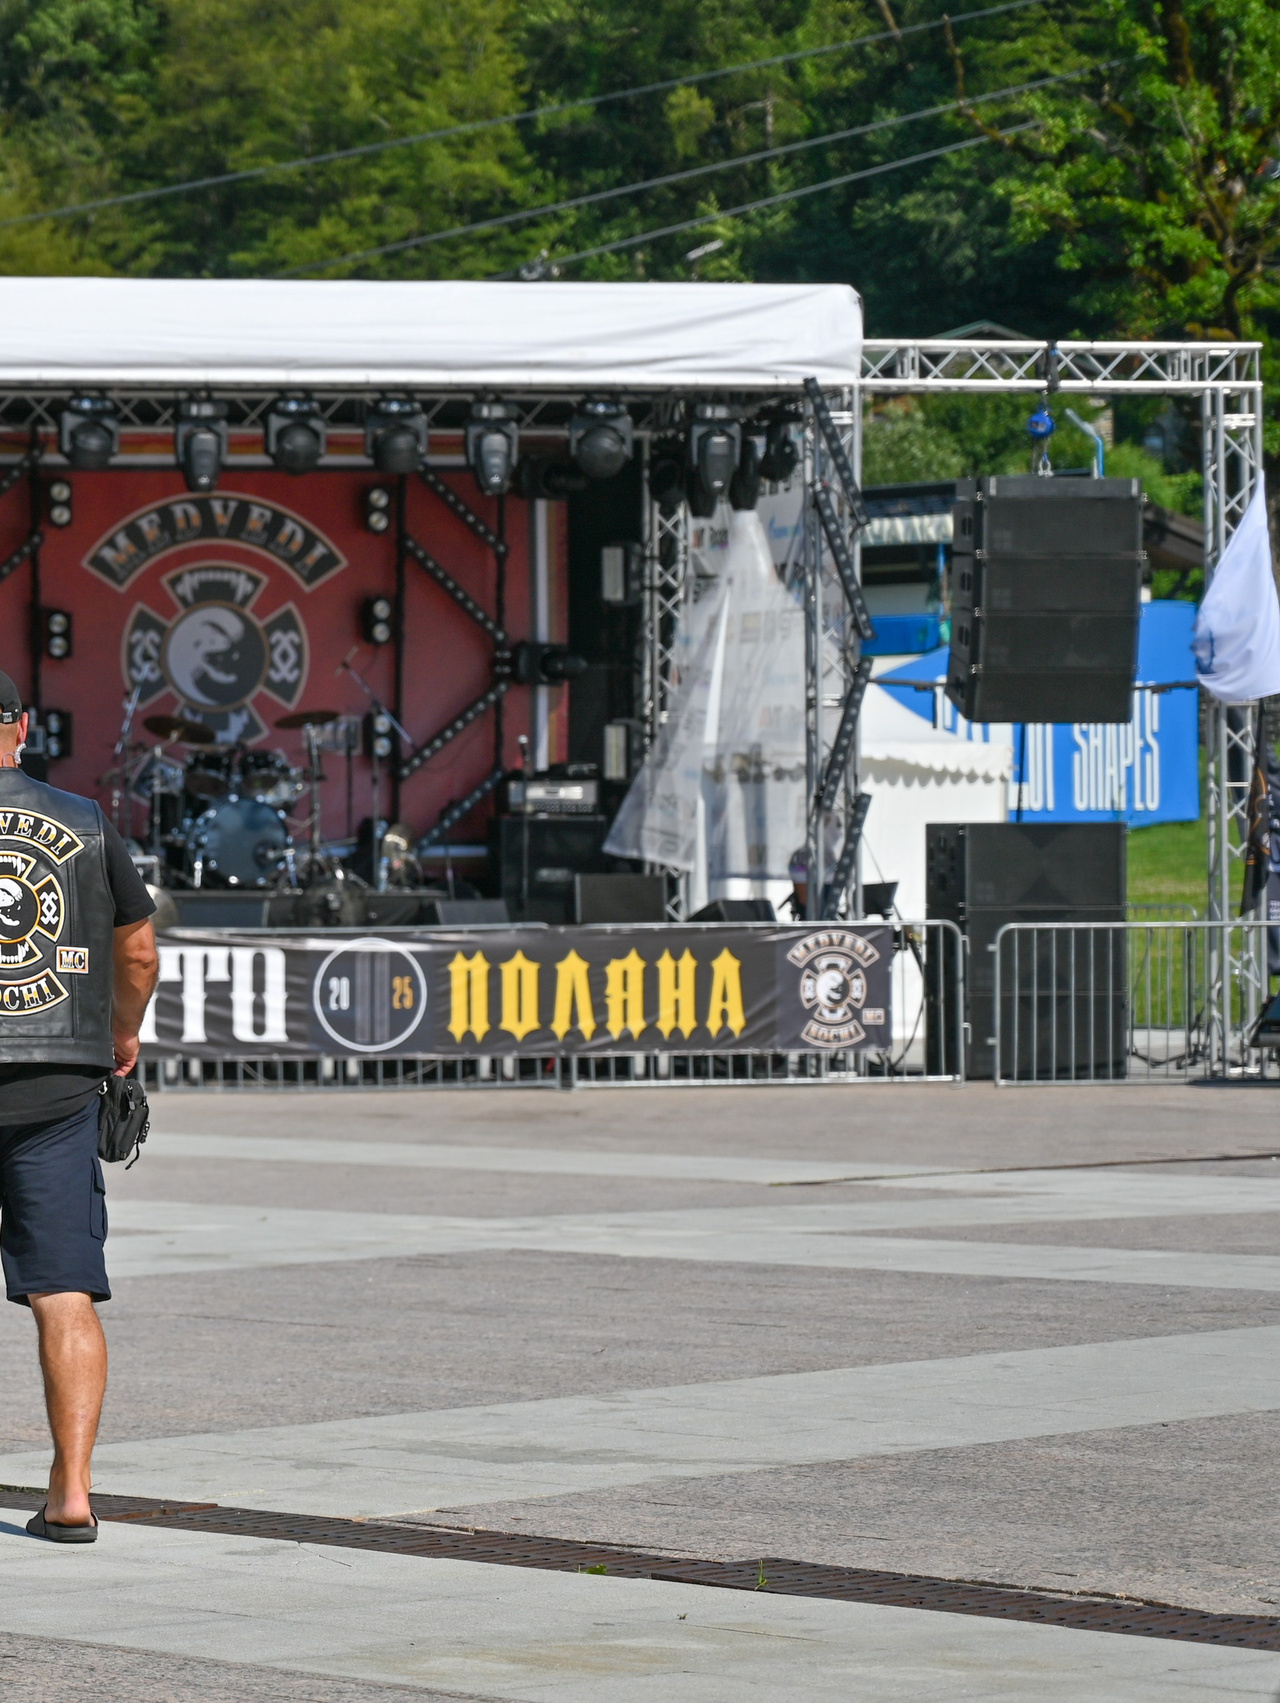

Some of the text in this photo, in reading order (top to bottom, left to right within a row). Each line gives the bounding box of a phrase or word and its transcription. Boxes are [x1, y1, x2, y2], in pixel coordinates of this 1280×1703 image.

[99, 499, 329, 577] MEDVEDI
[1073, 681, 1160, 812] SHAPES
[61, 949, 86, 969] MC
[328, 976, 414, 1011] 20 25
[447, 946, 747, 1044] ПОЛЯНА
